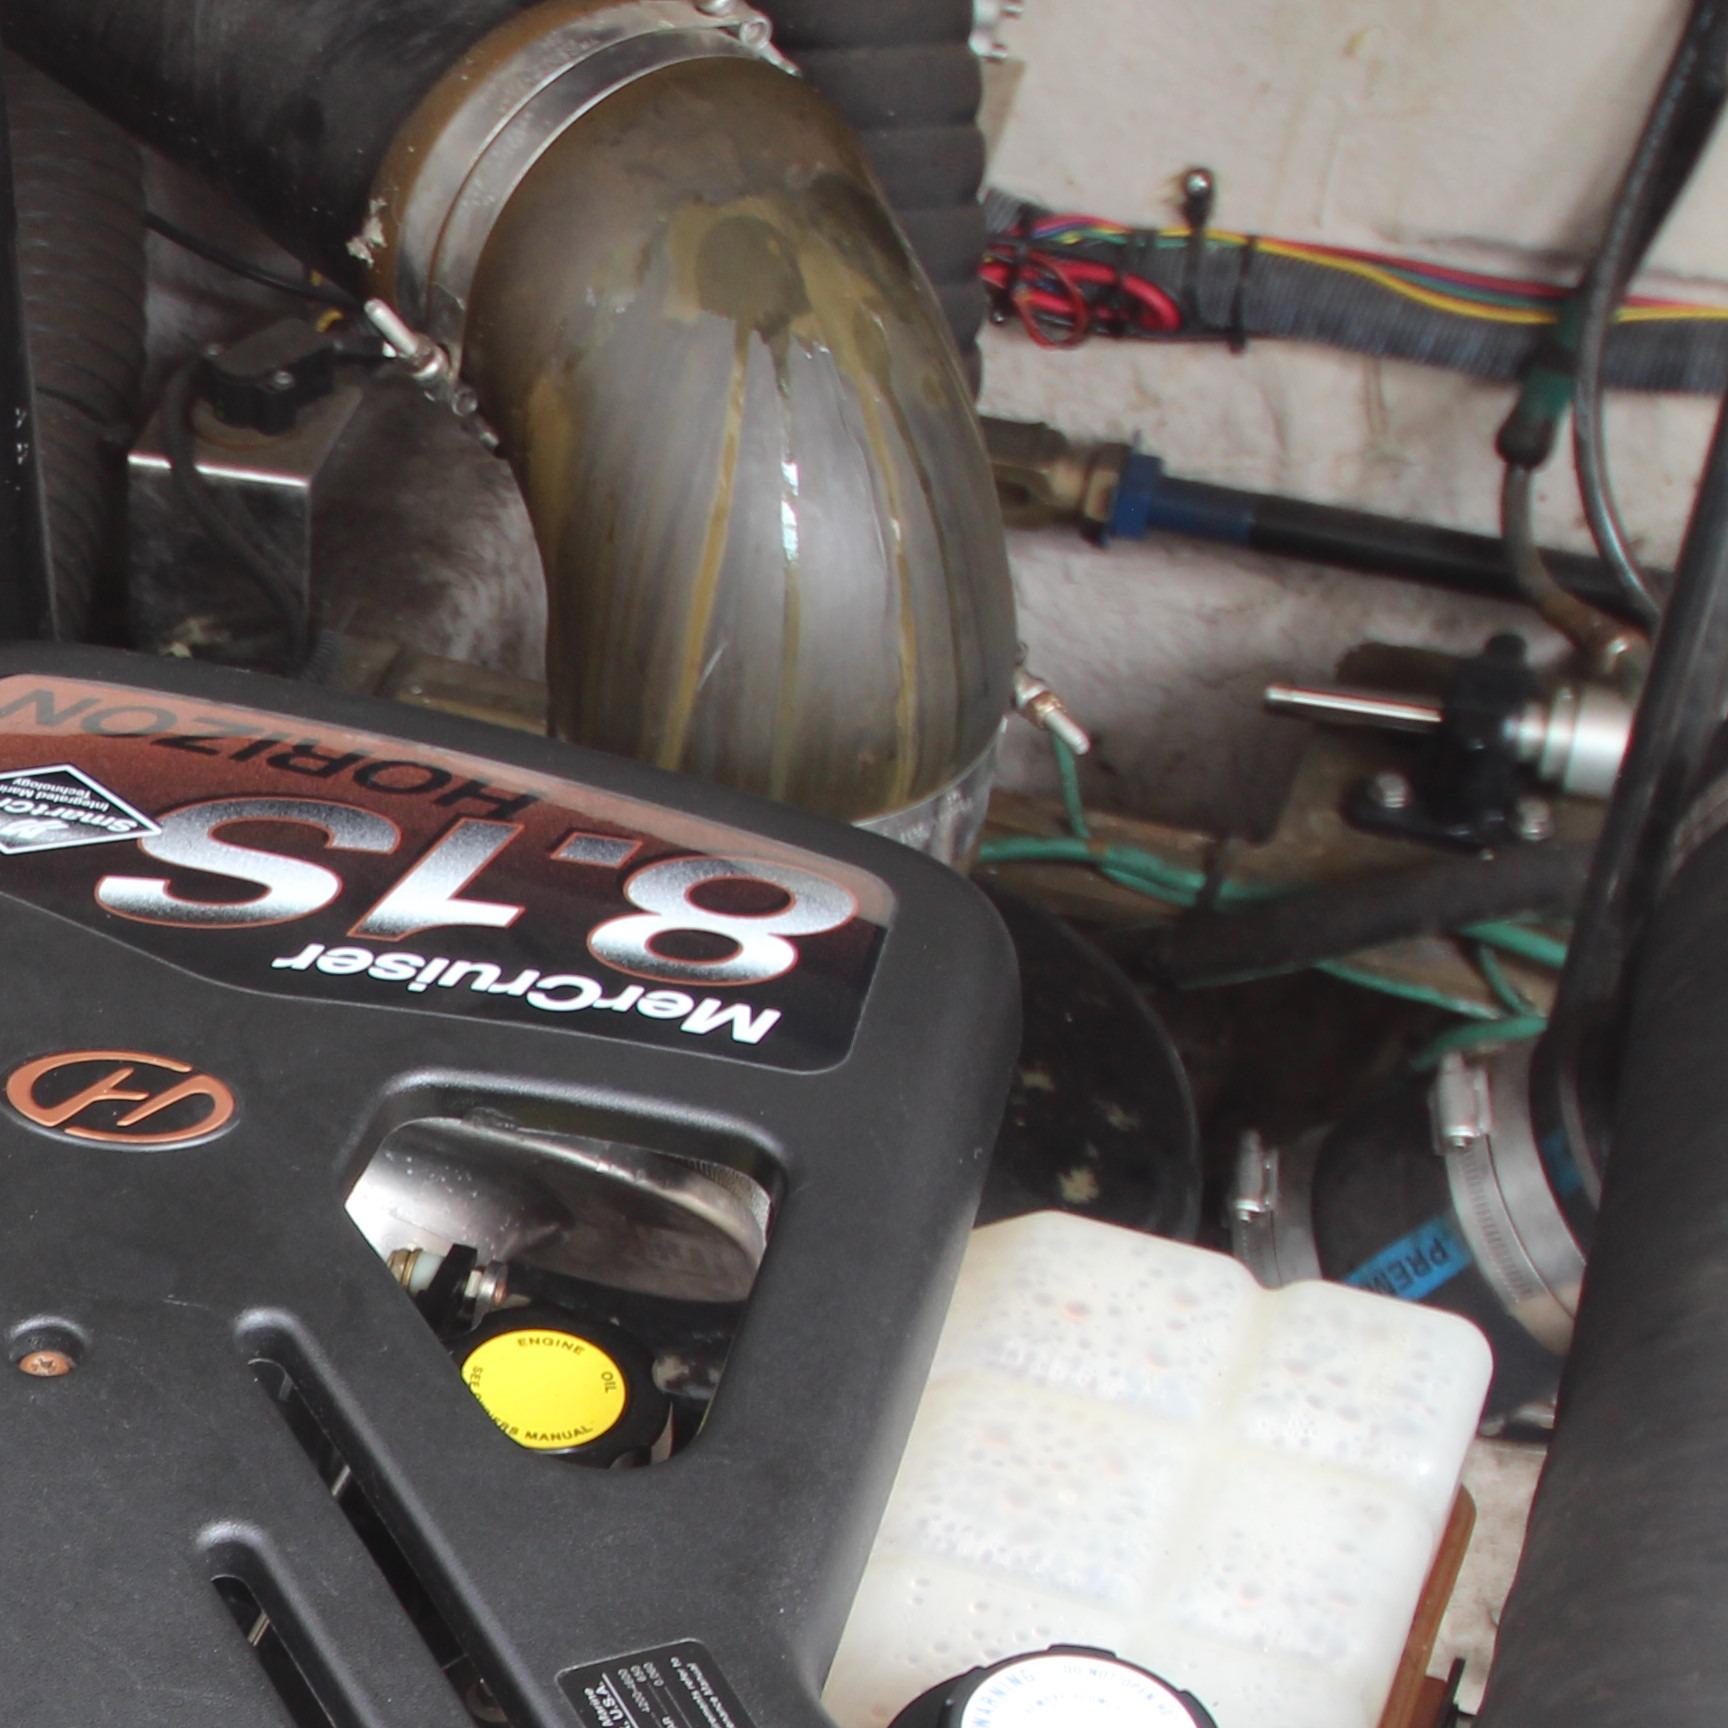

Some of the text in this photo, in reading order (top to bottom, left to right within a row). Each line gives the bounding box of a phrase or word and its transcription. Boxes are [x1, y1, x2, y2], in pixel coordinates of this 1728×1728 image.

[12, 778, 92, 798] Technology
[36, 792, 109, 812] Integrated
[96, 791, 857, 984] 8.1S
[273, 942, 780, 1043] MerCruiser
[517, 1337, 616, 1393] ENGINE OIL
[525, 1426, 593, 1441] MANUAL
[685, 1661, 715, 1696] Manual
[970, 1667, 1036, 1728] WARNING
[580, 1686, 614, 1727] Marine
[591, 1681, 624, 1720] U.S.A.
